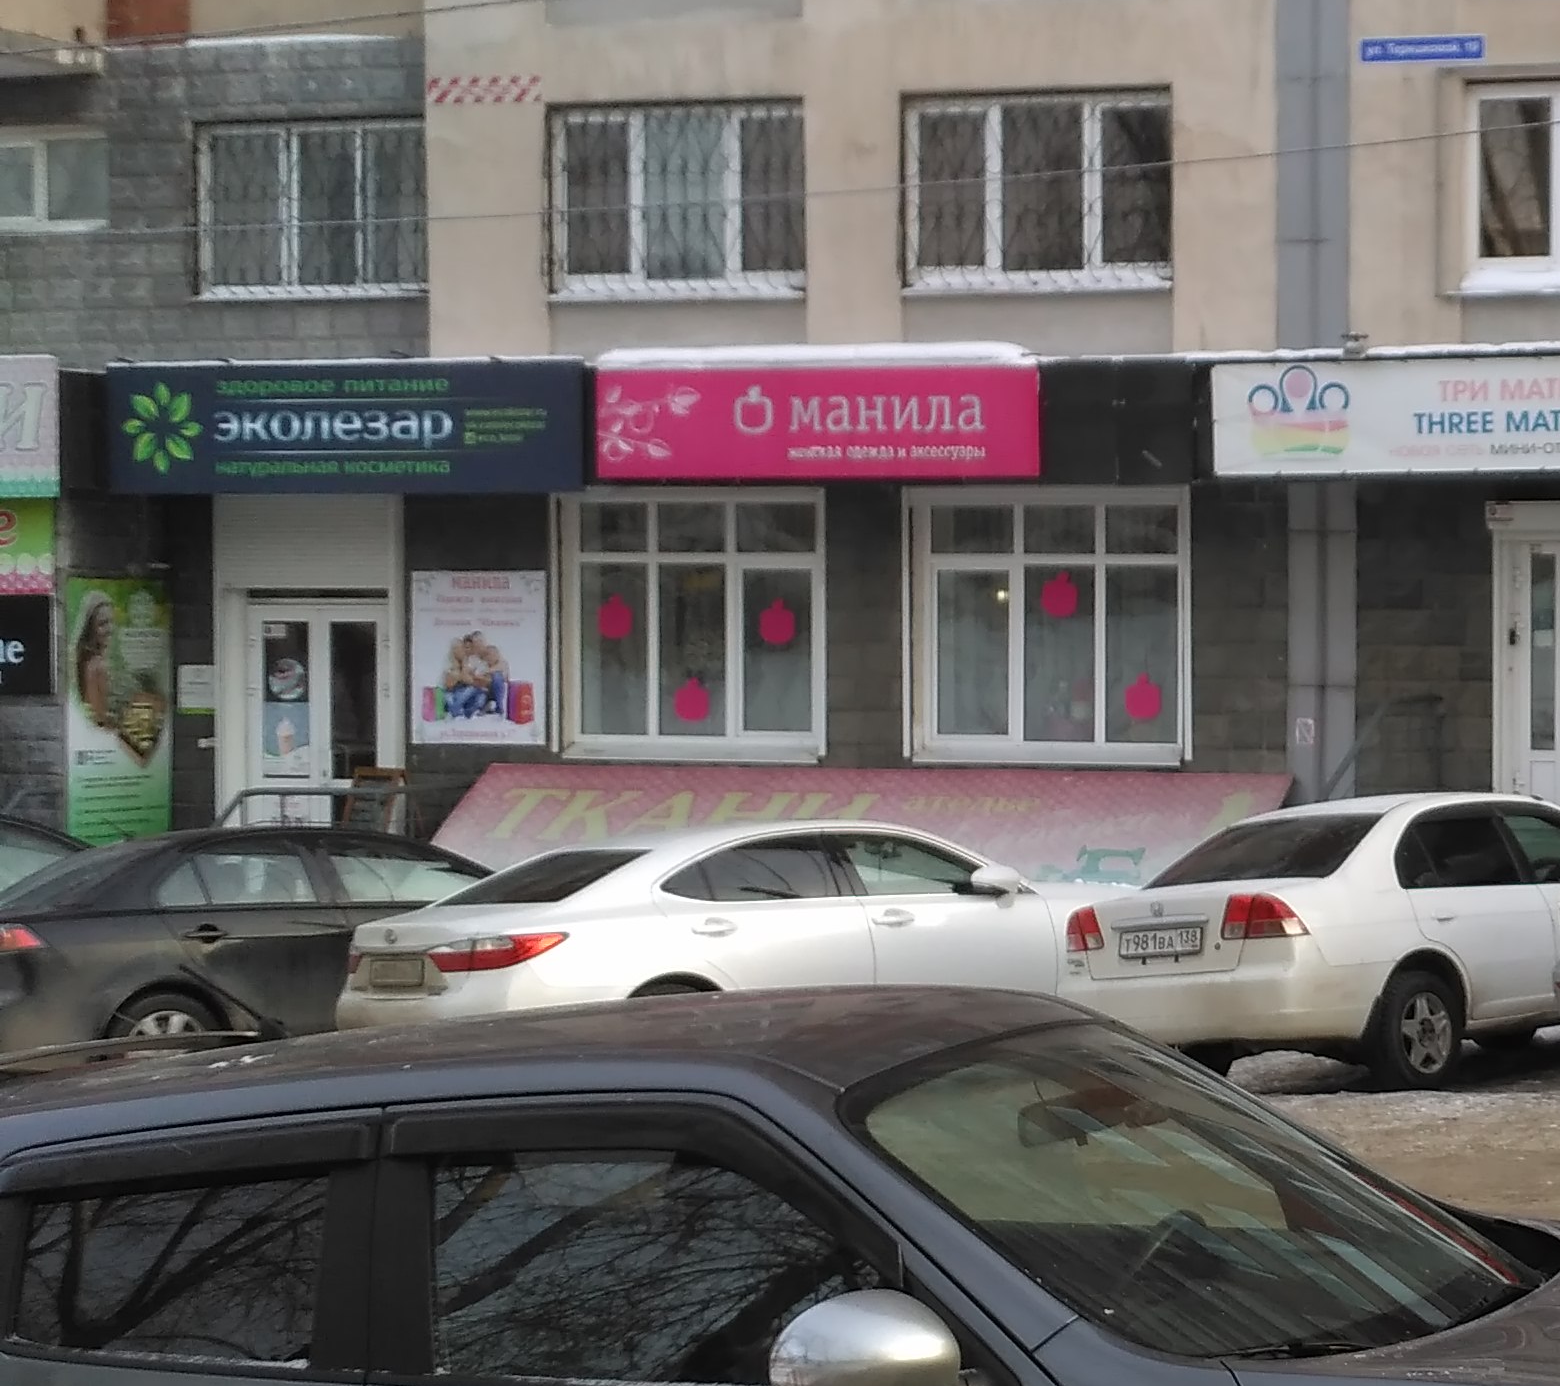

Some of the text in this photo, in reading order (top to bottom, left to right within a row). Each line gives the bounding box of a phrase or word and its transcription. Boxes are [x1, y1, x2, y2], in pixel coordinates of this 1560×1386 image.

[344, 377, 449, 393] питание
[1438, 380, 1488, 402] ТРИ
[788, 393, 986, 433] манила
[1414, 411, 1494, 434] THREE
[213, 409, 453, 449] эколезар
[846, 445, 895, 460] одежда
[897, 447, 906, 457] и
[909, 444, 986, 461] аксессуары
[1124, 930, 1198, 952] Т981ВА 138
